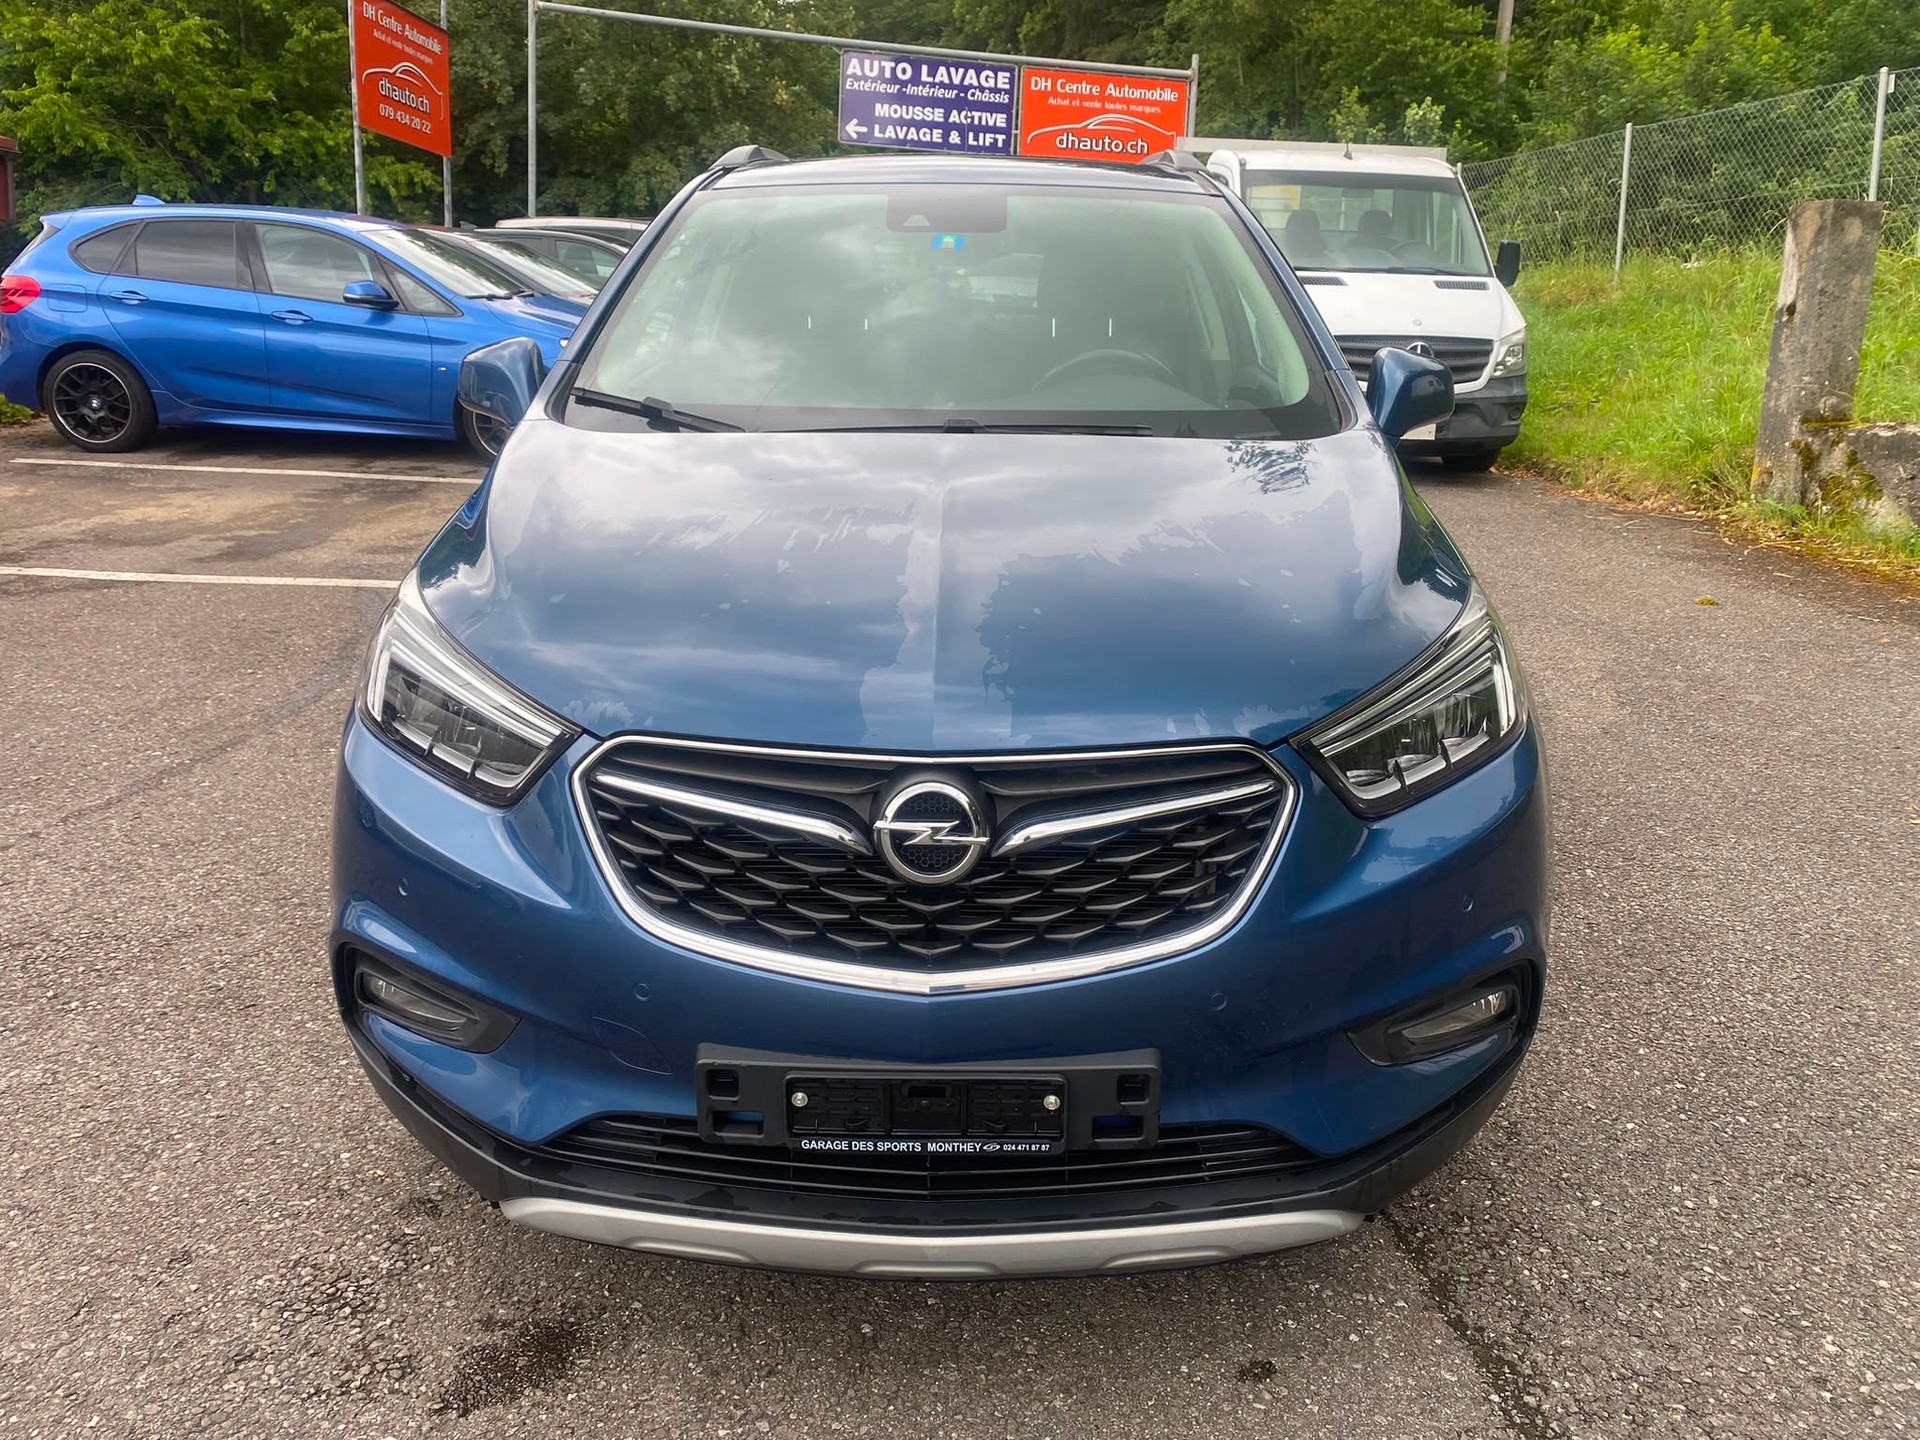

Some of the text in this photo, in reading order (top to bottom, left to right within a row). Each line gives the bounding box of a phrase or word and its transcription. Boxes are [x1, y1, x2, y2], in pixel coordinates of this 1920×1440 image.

[363, 1, 375, 21] DH
[378, 10, 402, 35] Centre
[404, 24, 442, 55] Automobile
[846, 58, 1011, 90] AUTO LAVAGE
[378, 77, 430, 114] dhauto.ch
[846, 78, 900, 93] Extérieur
[967, 88, 1010, 104] Châssis
[1030, 76, 1179, 103] DH Centre Automobile
[379, 103, 431, 134] 079 434 20 22
[875, 102, 1007, 127] MOUSSE ACTIVE
[874, 124, 1007, 148] LAVAGE & LIFT
[1056, 131, 1149, 155] dhauto.ch
[801, 1139, 849, 1151] GARAGE
[851, 1141, 874, 1152] DES
[876, 1141, 922, 1152] SPORTS
[927, 1142, 982, 1153] MONTHEY
